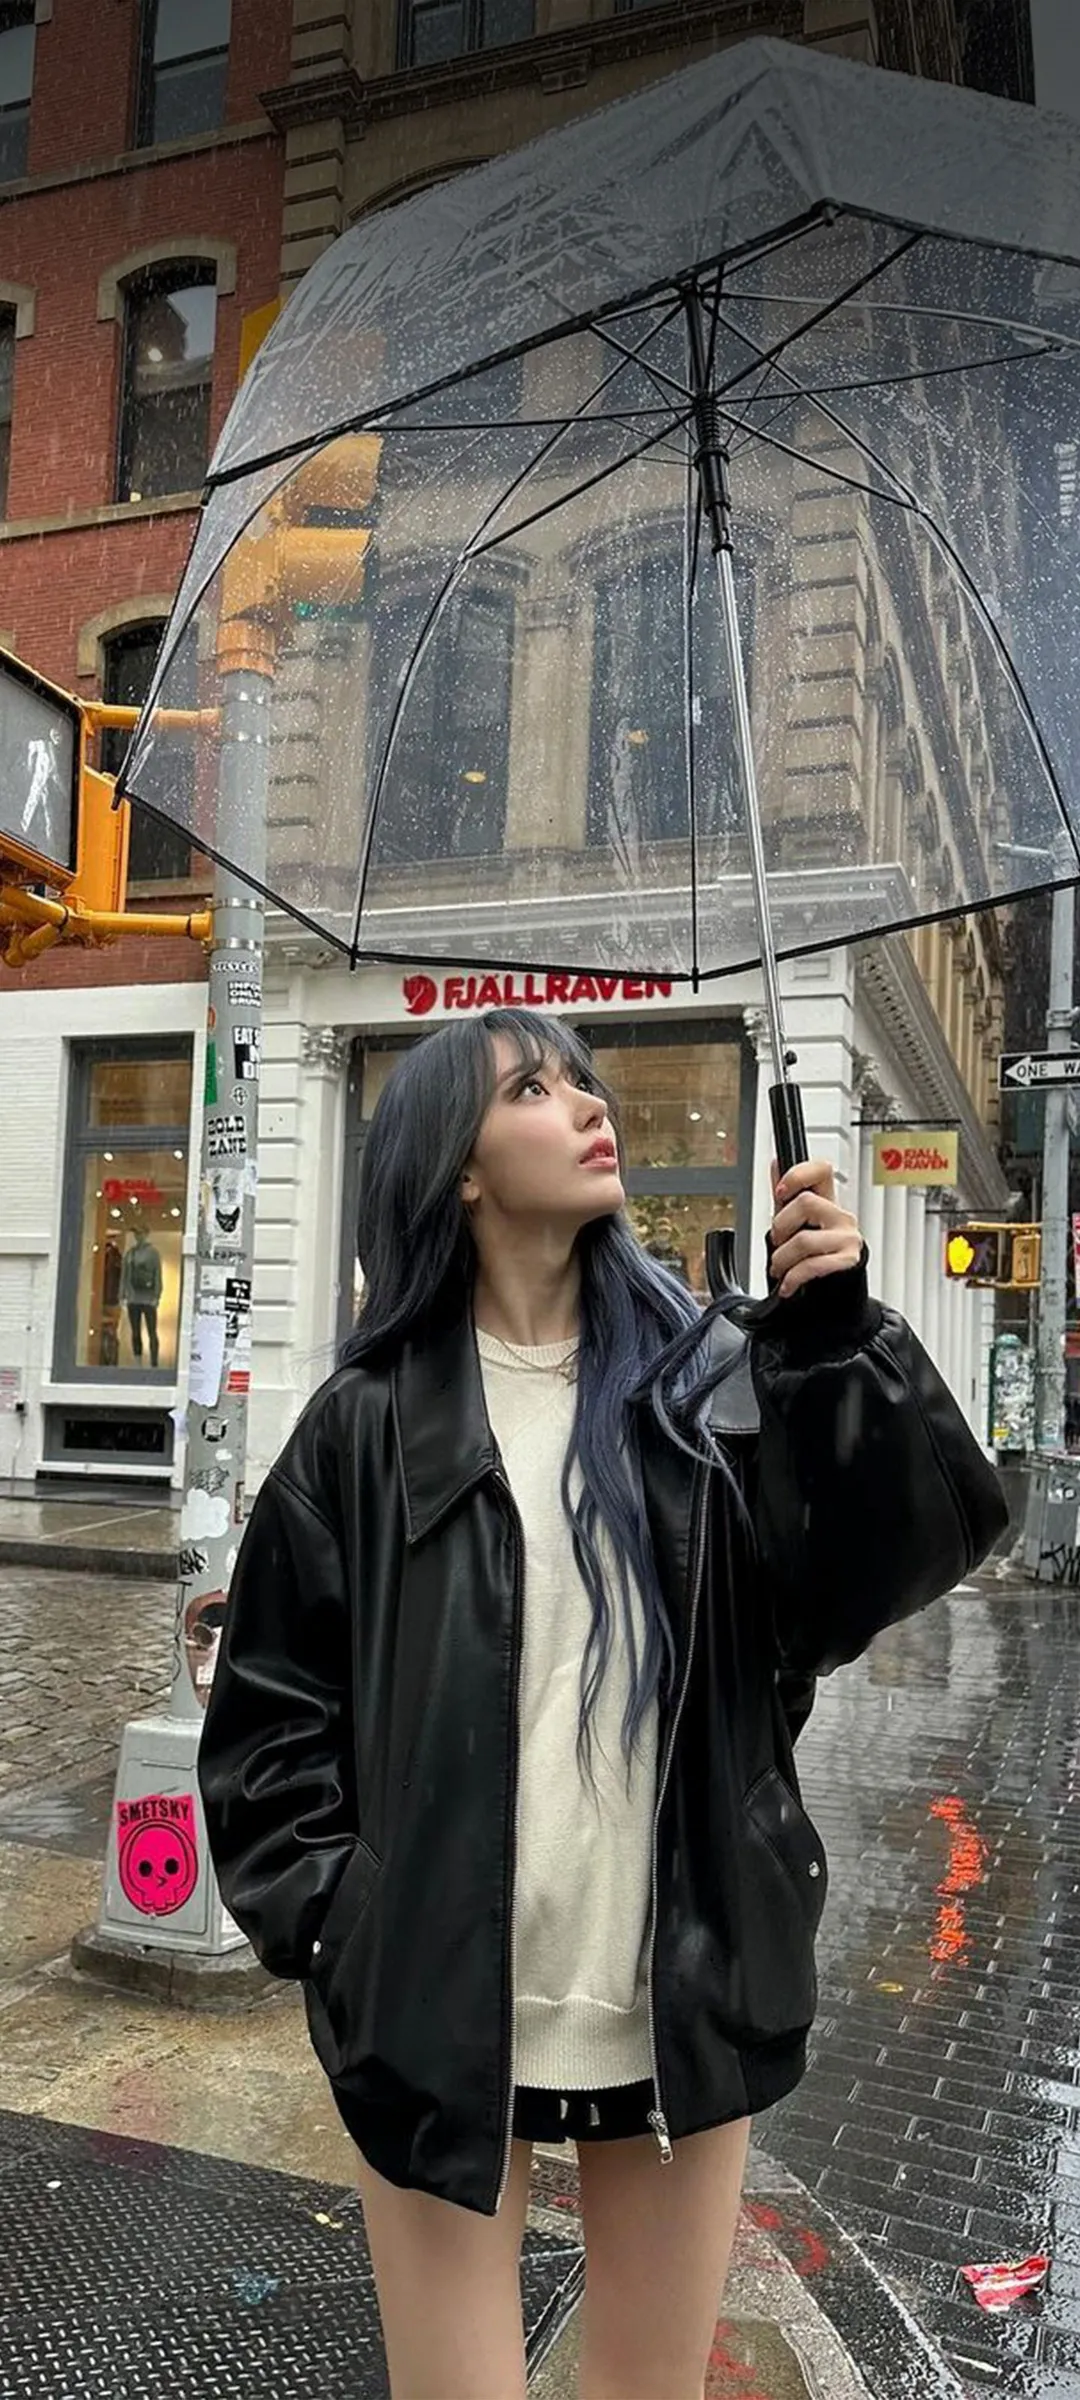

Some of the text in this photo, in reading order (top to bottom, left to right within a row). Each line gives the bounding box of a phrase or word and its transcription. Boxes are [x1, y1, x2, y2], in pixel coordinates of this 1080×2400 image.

[1016, 1061, 1080, 1078] ONE W
[119, 1799, 189, 1826] SMETSKY
